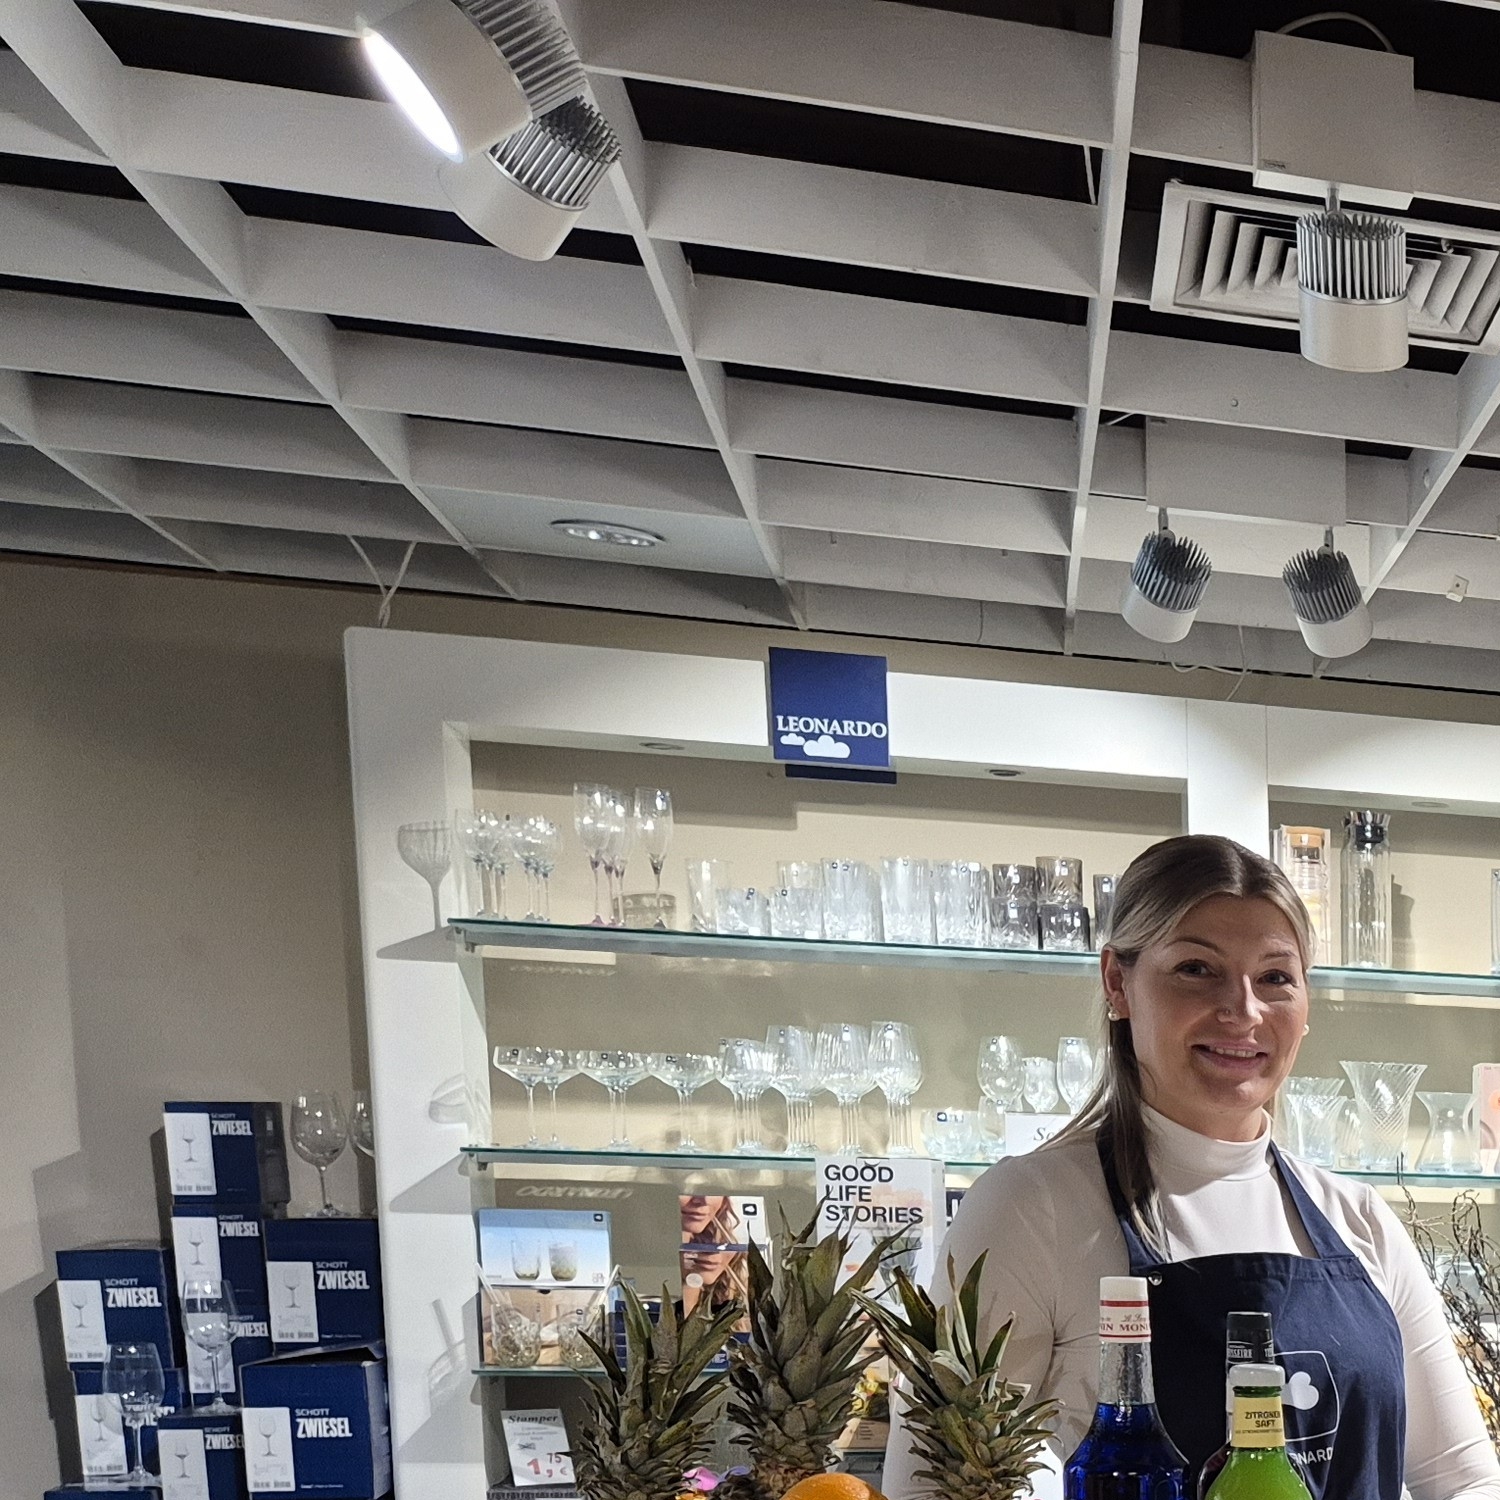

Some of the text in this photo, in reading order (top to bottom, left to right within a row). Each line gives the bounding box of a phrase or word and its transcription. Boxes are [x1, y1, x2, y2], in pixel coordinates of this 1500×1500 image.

[776, 714, 888, 739] LEONARDO
[212, 1120, 253, 1136] ZWIESEL
[824, 1164, 894, 1183] GOOD
[825, 1184, 872, 1203] LIFE
[825, 1205, 923, 1224] STORIES
[219, 1221, 260, 1237] ZWIESEL
[317, 1270, 370, 1290] ZWIESEL
[106, 1287, 162, 1308] ZWIESEL
[1119, 1322, 1150, 1333] MONI
[296, 1417, 353, 1439] ZWIESEL
[508, 1414, 558, 1425] Stamper
[1255, 1419, 1275, 1429] SAFT
[205, 1433, 245, 1450] ZWIESE
